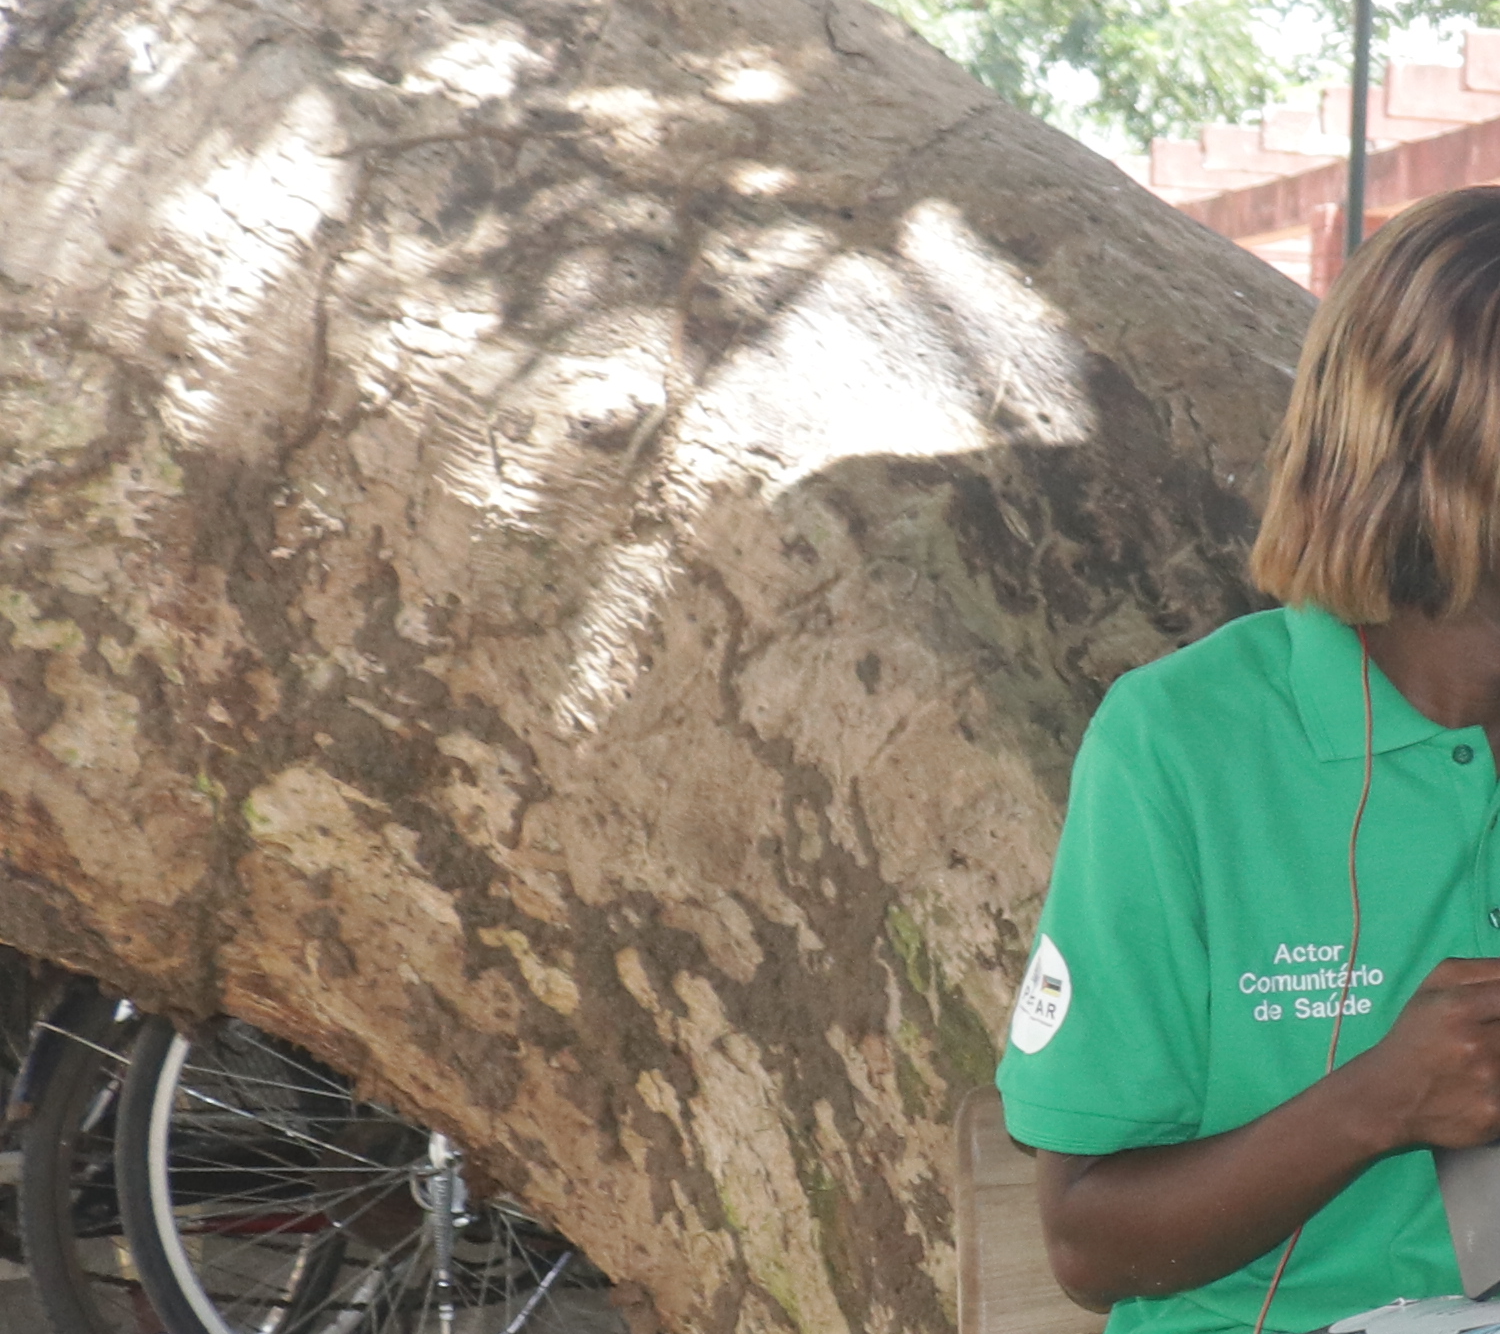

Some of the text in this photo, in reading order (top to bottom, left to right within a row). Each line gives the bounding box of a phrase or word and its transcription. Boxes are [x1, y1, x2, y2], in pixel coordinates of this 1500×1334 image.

[1273, 943, 1345, 965] Actor
[1238, 962, 1384, 995] Comunitário
[1253, 991, 1372, 1022] de Saúde
